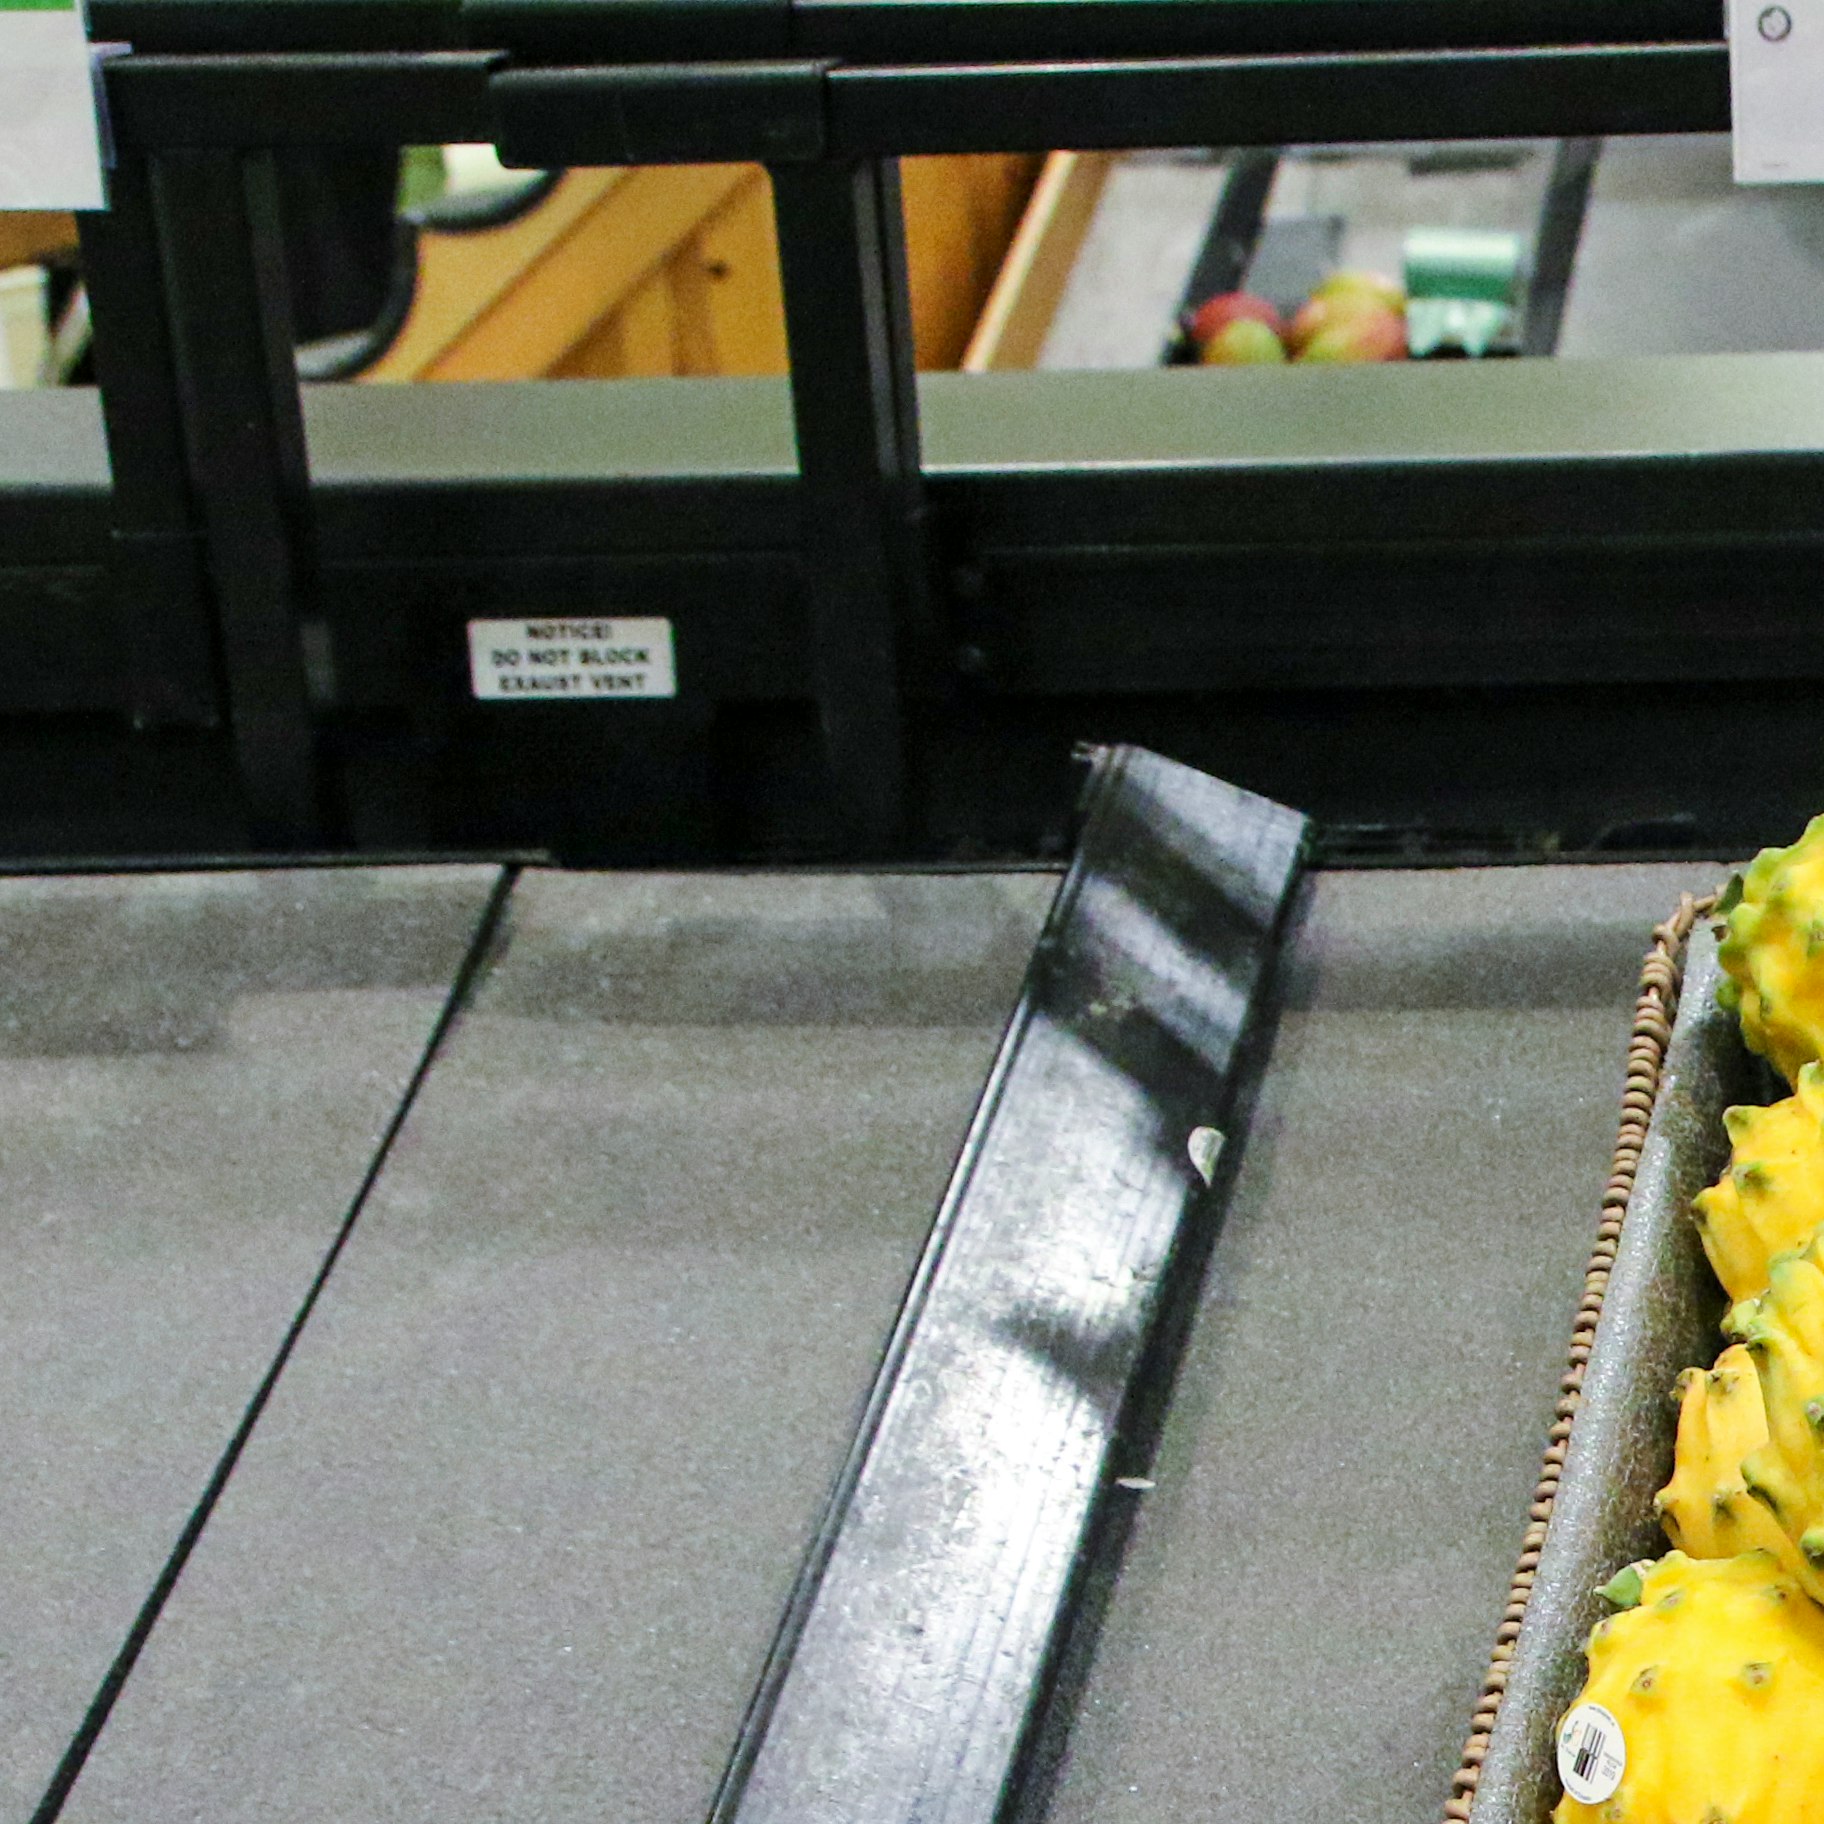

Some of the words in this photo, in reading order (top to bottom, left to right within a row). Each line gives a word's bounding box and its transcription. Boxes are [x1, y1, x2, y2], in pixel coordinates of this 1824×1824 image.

[491, 650, 520, 667] DO
[526, 650, 570, 666] NOT
[579, 649, 651, 666] BLOCK
[589, 673, 646, 690] VENT
